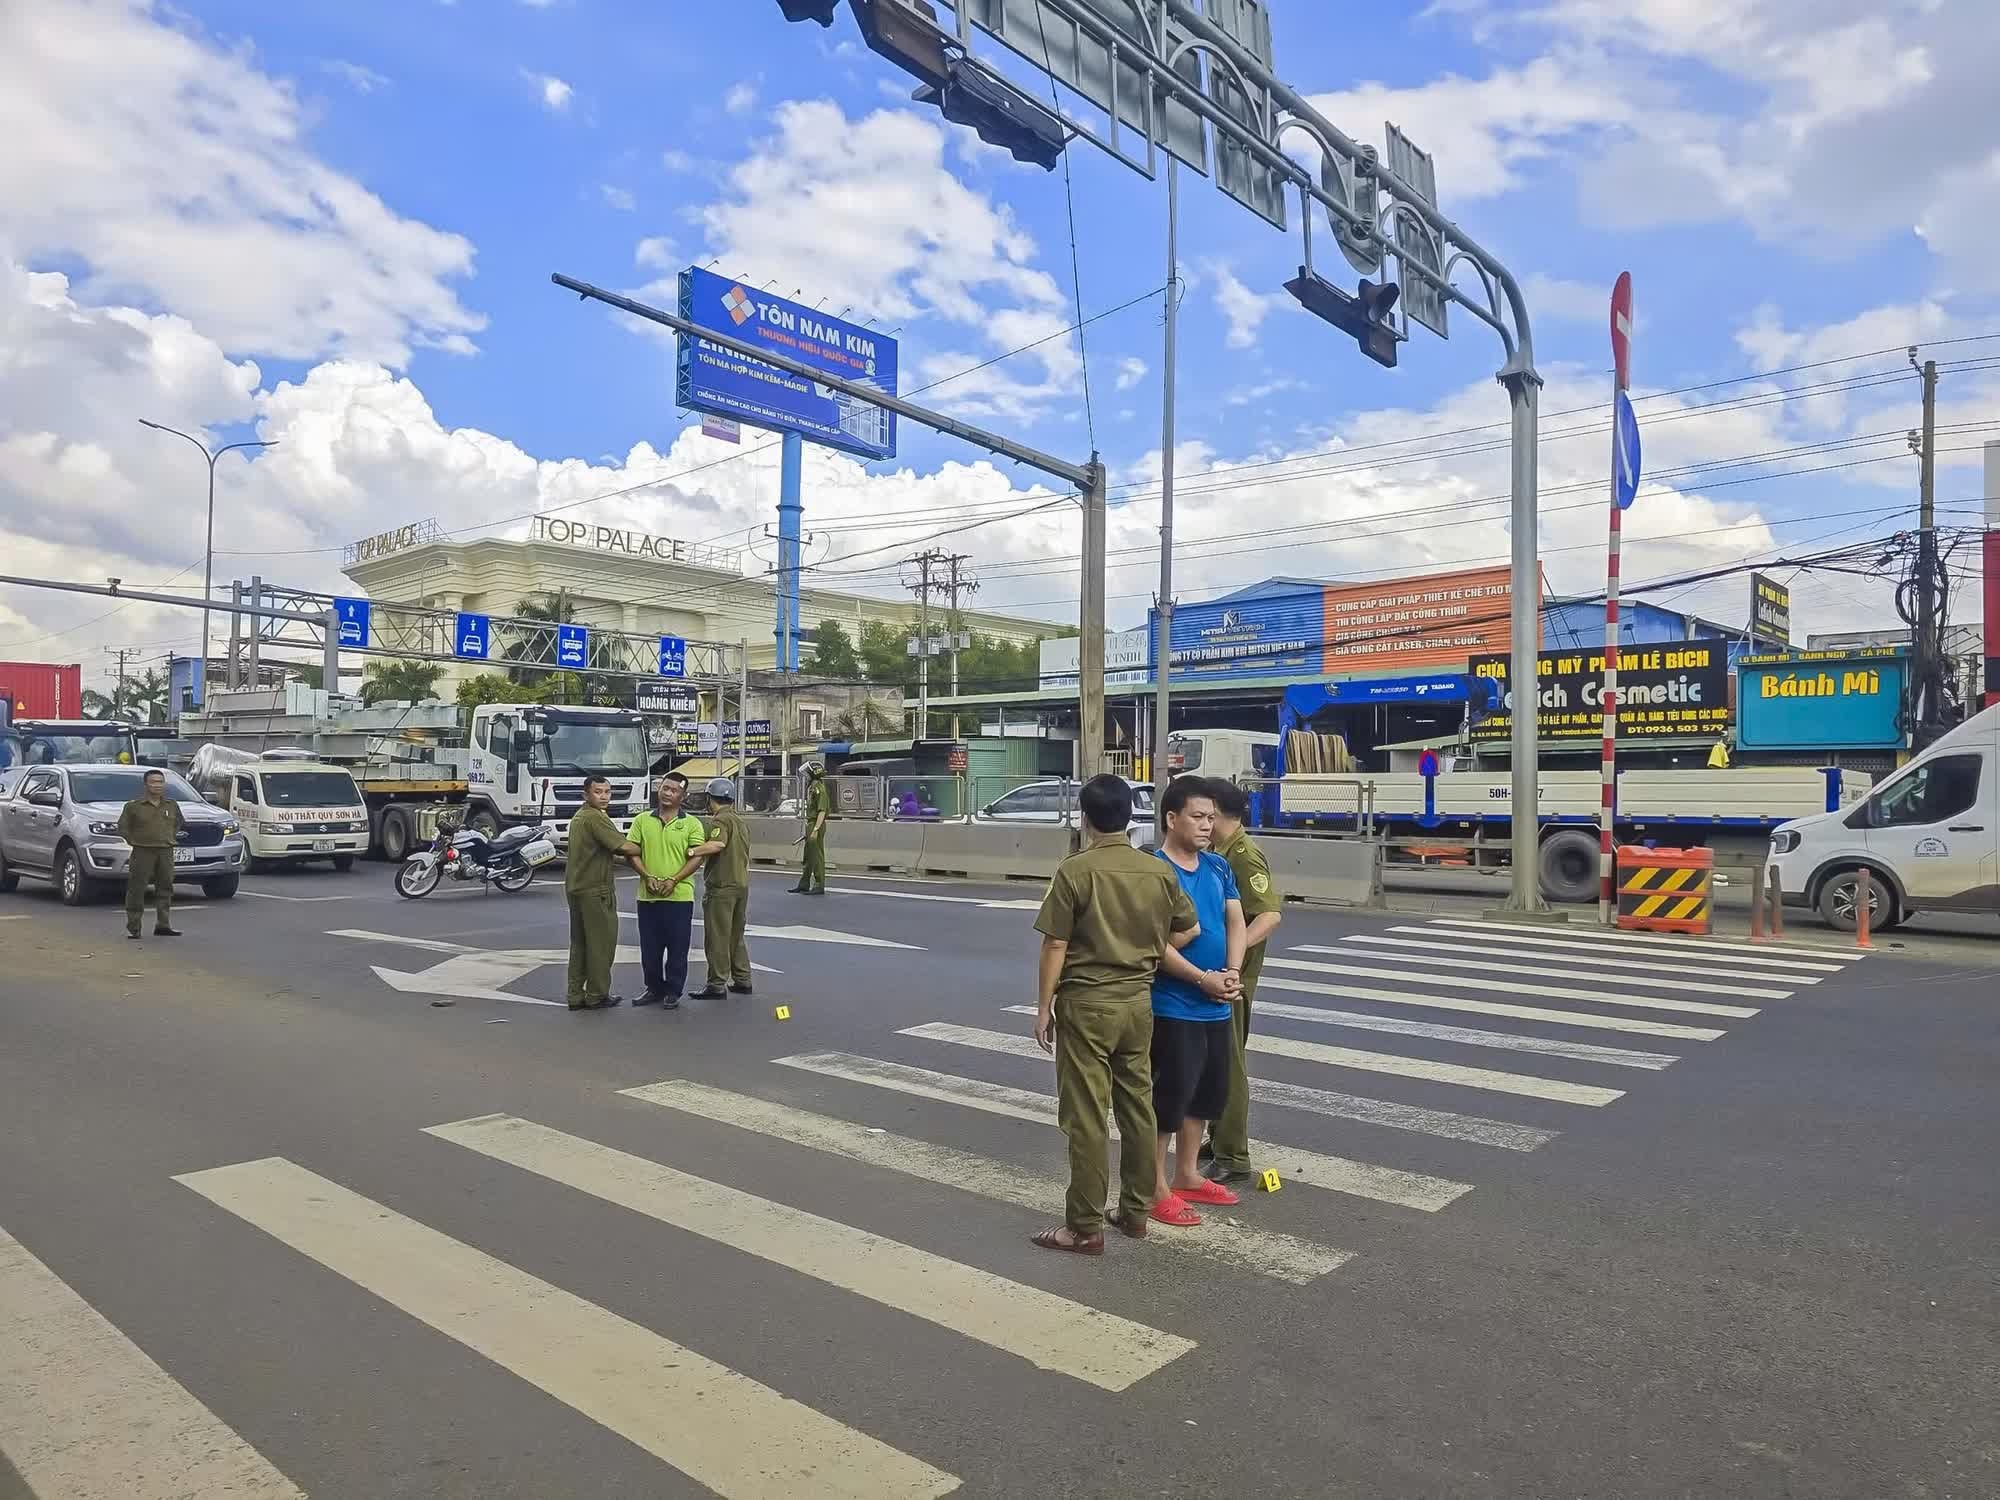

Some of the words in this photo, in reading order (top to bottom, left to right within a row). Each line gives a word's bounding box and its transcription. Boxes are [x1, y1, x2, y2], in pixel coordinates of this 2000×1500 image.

[757, 302, 795, 331] TÔN
[800, 317, 841, 347] NAM
[846, 334, 876, 358] KIM
[749, 369, 763, 380] KIM
[355, 537, 375, 561] TOP
[377, 523, 417, 556] PALACE
[534, 516, 587, 543] TOP
[596, 526, 686, 562] PALACE
[1336, 617, 1349, 627] THI
[1476, 659, 1506, 678] CỬA
[1557, 655, 1582, 675] MỸ
[1642, 650, 1661, 670] LÊ
[1665, 648, 1709, 669] BÍCH
[1761, 673, 1835, 698] Bánh
[1842, 669, 1879, 695] Mì
[1677, 724, 1698, 733] 503
[1702, 723, 1724, 732] 579
